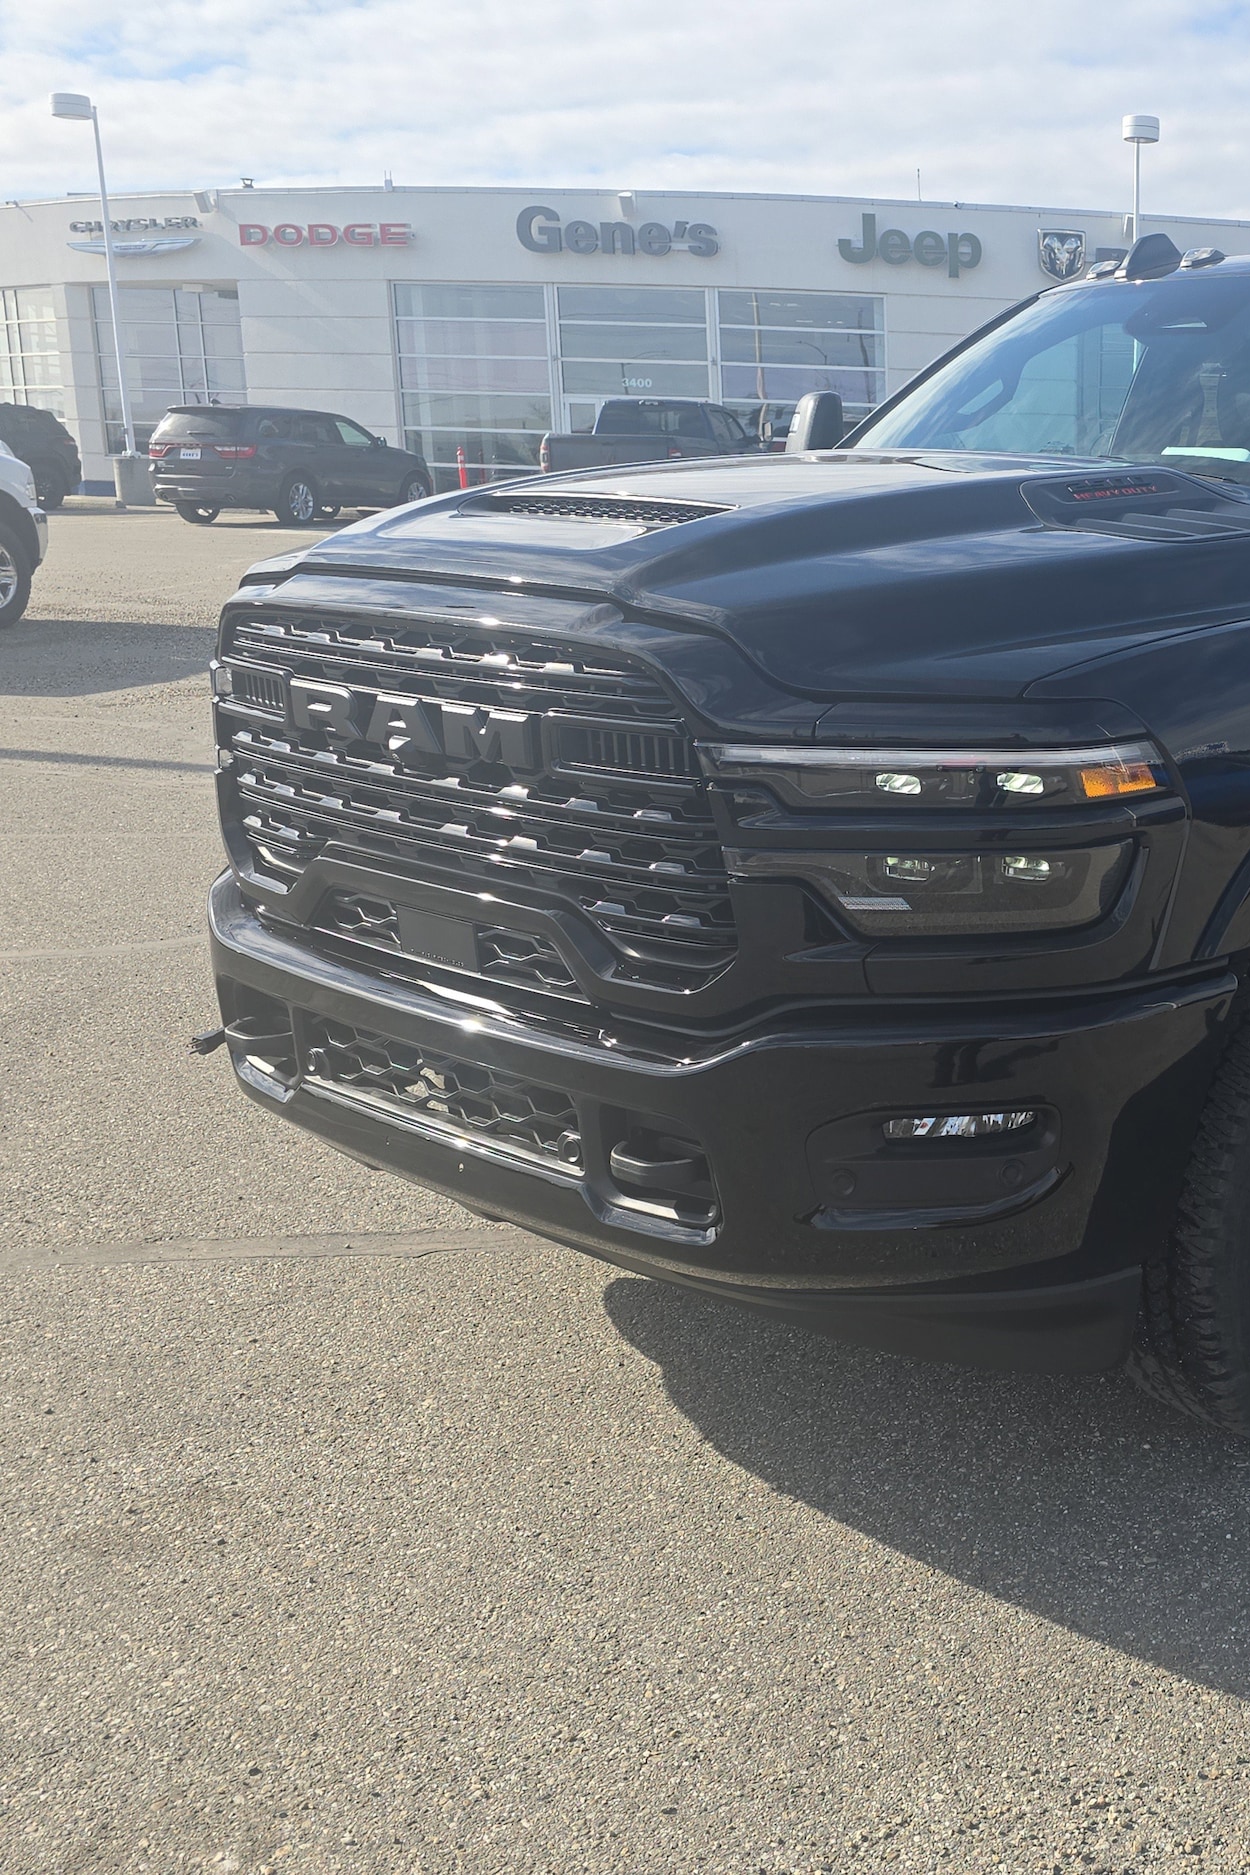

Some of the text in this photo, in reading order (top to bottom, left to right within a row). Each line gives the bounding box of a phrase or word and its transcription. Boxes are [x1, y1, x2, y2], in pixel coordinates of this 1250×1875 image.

[69, 217, 198, 233] CHRYSLER
[239, 223, 412, 247] DODGE
[516, 205, 719, 257] Gene's
[838, 213, 982, 278] Jeep
[622, 378, 652, 388] 3400
[1073, 485, 1157, 500] HEAVY DUTY
[290, 678, 535, 769] RAM
